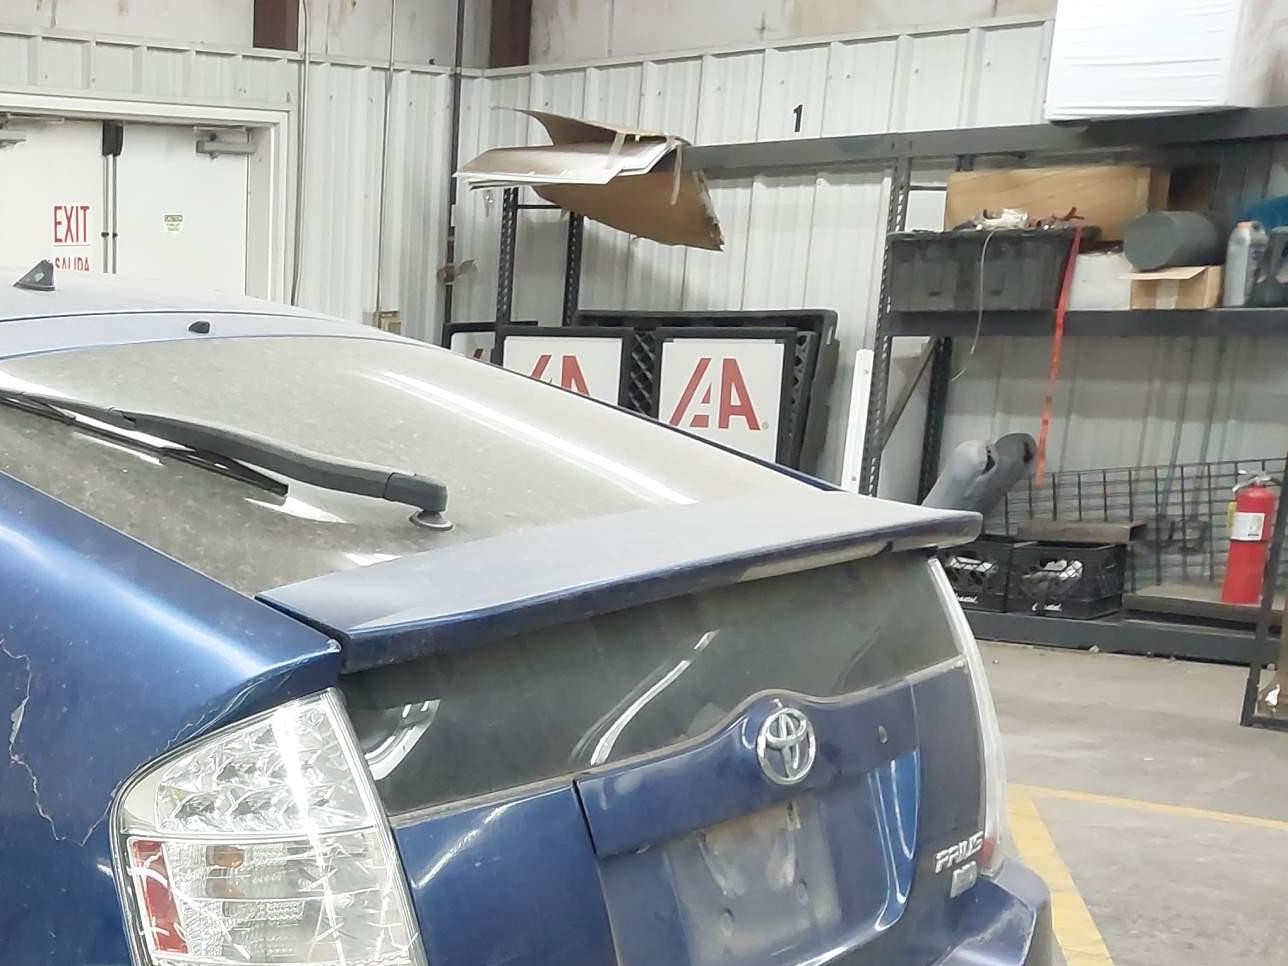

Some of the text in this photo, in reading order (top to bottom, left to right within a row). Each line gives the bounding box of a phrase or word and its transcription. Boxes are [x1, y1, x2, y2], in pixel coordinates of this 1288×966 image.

[793, 104, 804, 133] 1
[54, 205, 90, 243] EXIT
[935, 830, 984, 874] PRIUS
